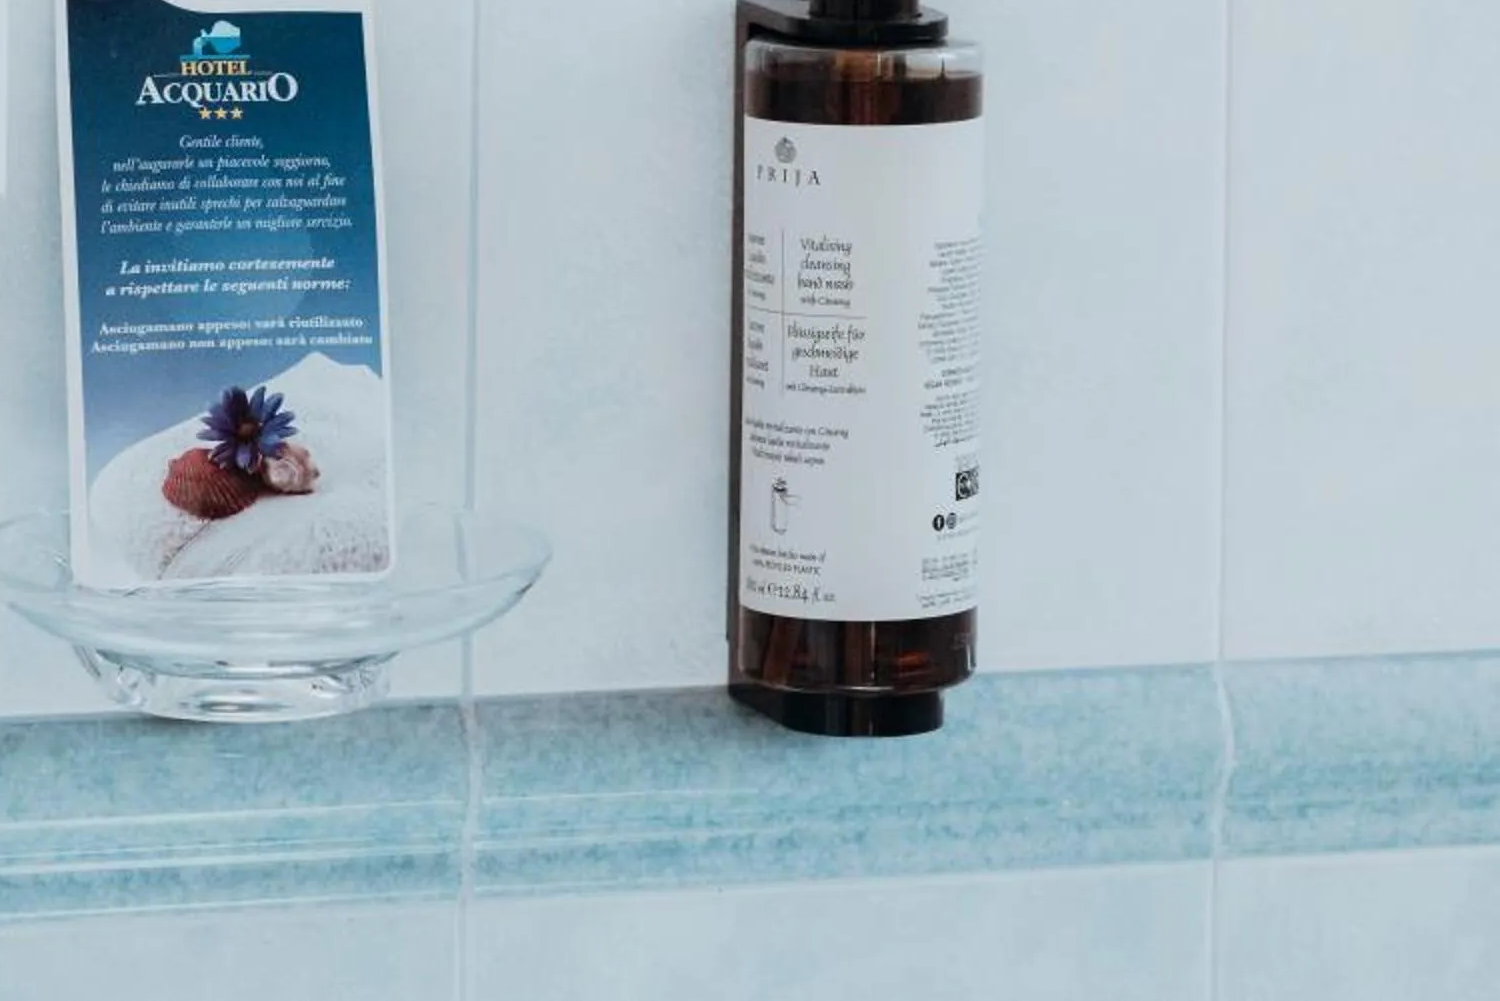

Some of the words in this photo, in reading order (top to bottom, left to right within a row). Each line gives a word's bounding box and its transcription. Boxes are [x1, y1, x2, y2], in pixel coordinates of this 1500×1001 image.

[179, 60, 252, 76] HOTEL
[135, 71, 299, 108] ACQUARIO
[179, 134, 222, 148] Gentile
[225, 134, 264, 149] cliente,
[215, 154, 270, 172] piacevole
[101, 179, 112, 193] le
[178, 175, 191, 190] di
[261, 178, 282, 188] con
[307, 173, 321, 187] al
[320, 172, 346, 191] fine
[100, 199, 114, 213] di
[116, 199, 157, 212] evitare
[159, 197, 197, 210] inutili
[199, 195, 241, 214] sprechi
[243, 198, 263, 212] per
[165, 221, 173, 232] e
[255, 215, 303, 232] migliore
[119, 260, 141, 275] La
[144, 258, 225, 273] invitiamo
[228, 256, 335, 270] cortesemente
[105, 286, 116, 297] a
[119, 282, 200, 299] rispettare
[203, 278, 219, 292] le
[221, 276, 289, 296] seguenti
[291, 279, 351, 291] norme:
[99, 321, 194, 337] Asciugamano
[288, 315, 364, 328] riutilizzato
[90, 340, 185, 355] Asciugamano
[188, 339, 216, 349] non
[309, 331, 373, 345] cambiato
